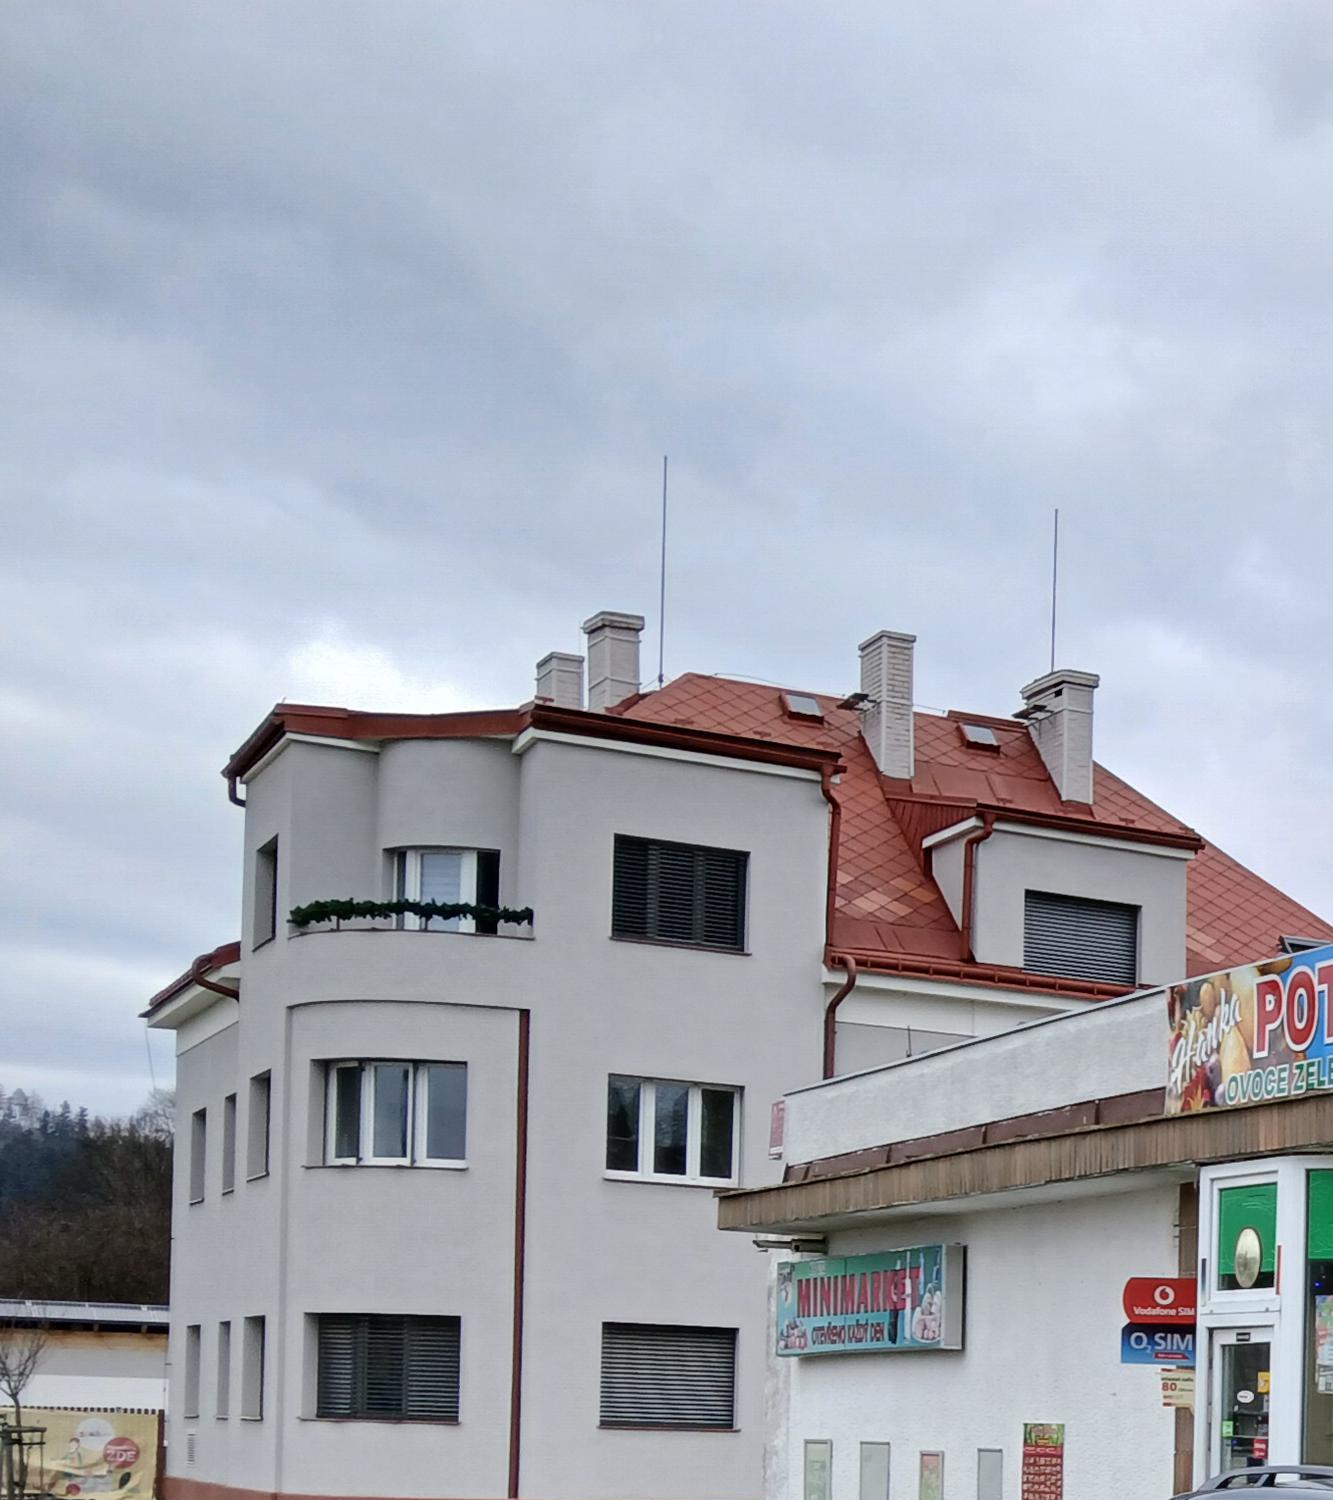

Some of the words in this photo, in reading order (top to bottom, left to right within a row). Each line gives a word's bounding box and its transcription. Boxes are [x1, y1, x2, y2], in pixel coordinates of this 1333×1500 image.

[1171, 987, 1242, 1094] Hanka
[1225, 1064, 1290, 1105] OVOCE
[797, 1267, 922, 1318] MINIMARKET
[1133, 1306, 1177, 1316] Vodafone
[1178, 1306, 1195, 1316] SIM
[1154, 1333, 1193, 1351] SIM
[1161, 1382, 1178, 1392] 80
[106, 1450, 137, 1462] ZDE
